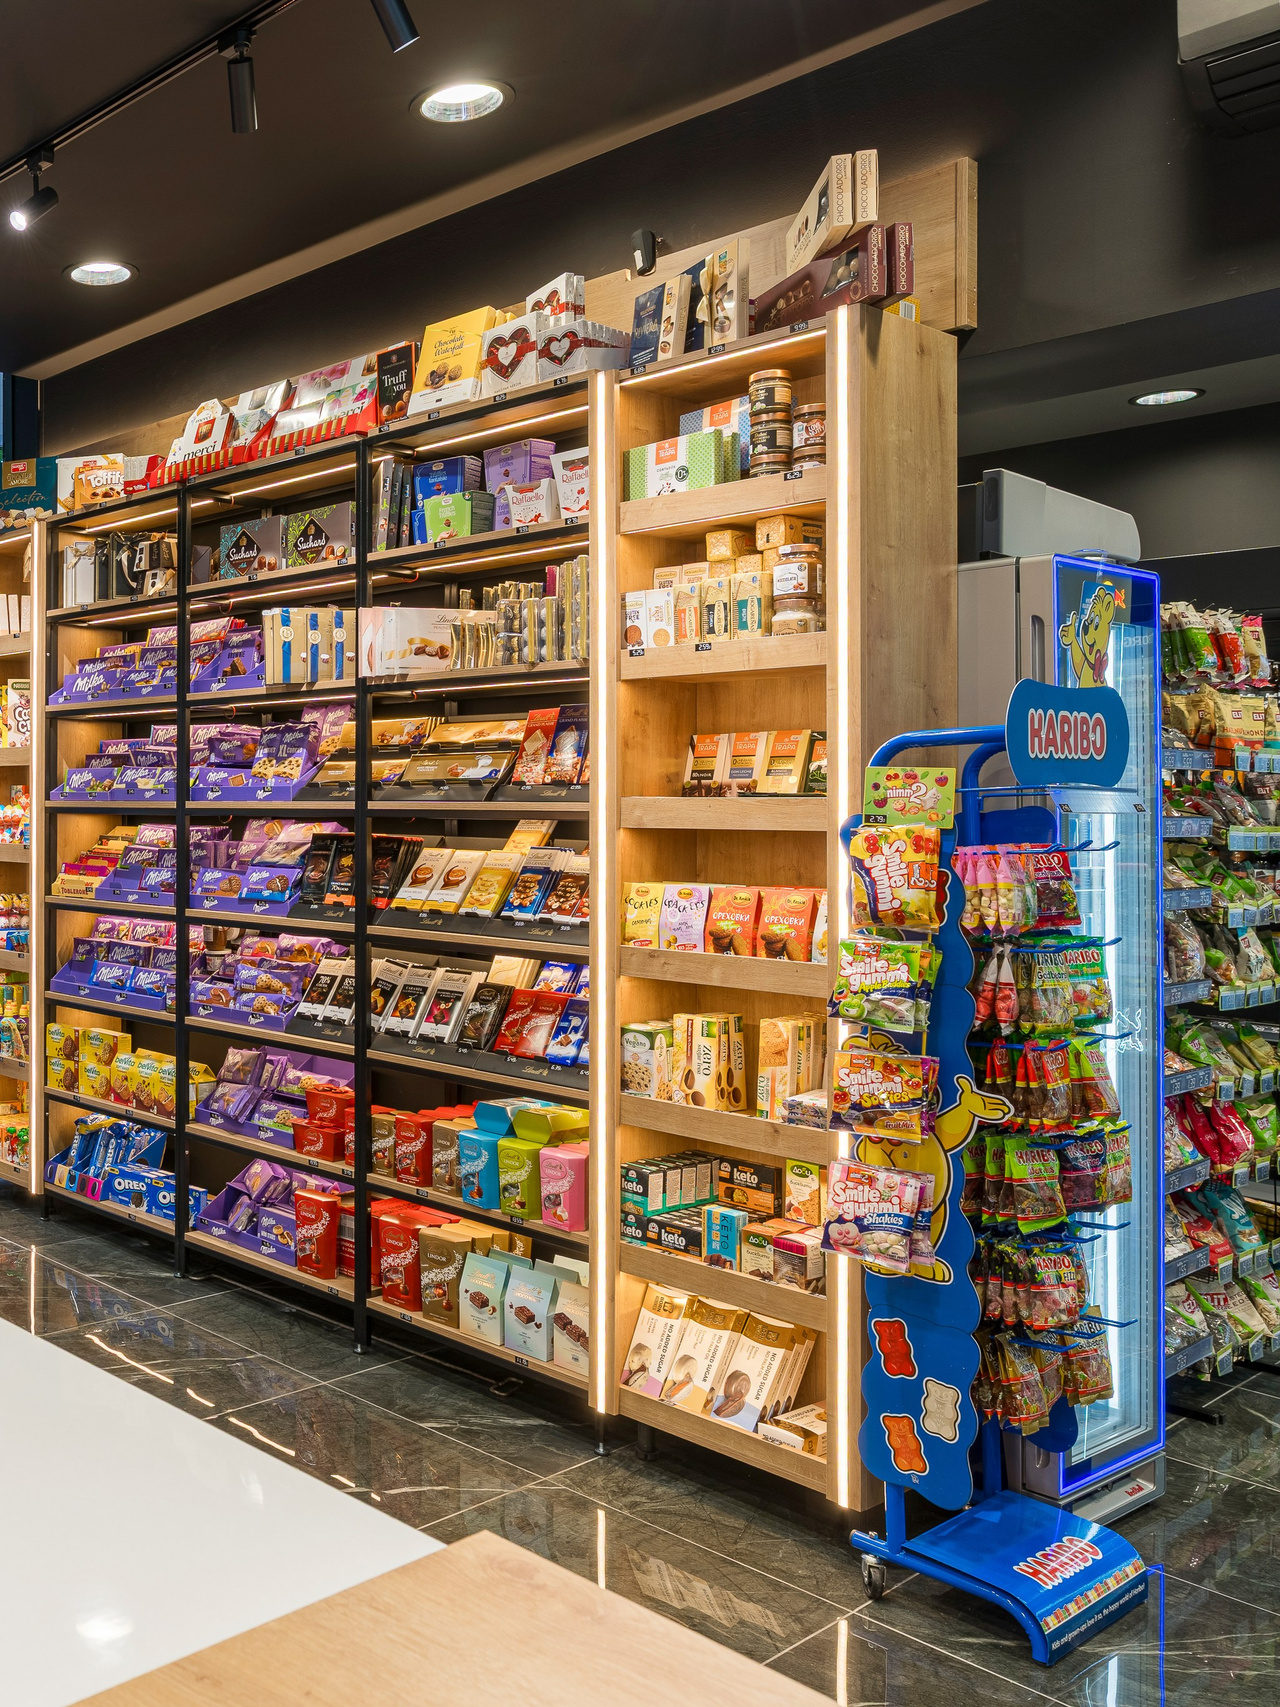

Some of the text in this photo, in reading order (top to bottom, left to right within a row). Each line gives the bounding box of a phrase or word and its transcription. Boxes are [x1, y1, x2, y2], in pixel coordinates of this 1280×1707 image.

[434, 335, 464, 349] Chocolate
[383, 370, 407, 388] Truff
[183, 441, 217, 461] merci
[512, 494, 544, 505] Raffaello
[298, 536, 326, 550] Suchard
[229, 549, 258, 562] Suchard
[73, 671, 105, 693] Milka
[1029, 709, 1106, 759] HARIBO
[70, 771, 93, 788] Milka
[121, 767, 149, 782] Milka
[201, 870, 222, 883] Milka
[248, 870, 270, 883] Milka
[865, 839, 909, 912] Smile gummi
[625, 897, 659, 909] COOKIES
[712, 912, 750, 922] ОРЕХОВКИ
[765, 916, 805, 925] ОРЕХОВКИ
[97, 966, 123, 982] Milka
[840, 956, 889, 976] Smile
[136, 971, 161, 985] Milka
[850, 966, 909, 992] gummi
[48, 1028, 65, 1038] belVita
[624, 1037, 646, 1048] Vegano
[115, 1056, 135, 1067] belVita
[839, 1068, 883, 1087] Smile
[849, 1077, 902, 1100] gummi
[1015, 1149, 1057, 1165] HARIBO
[734, 1168, 758, 1183] keto
[113, 1177, 147, 1191] OREO
[622, 1180, 643, 1193] keto
[832, 1182, 881, 1203] Smile
[300, 1210, 315, 1220] LINDOR
[842, 1197, 902, 1220] gummi
[864, 1213, 904, 1226] Shakies
[621, 1223, 642, 1238] keto
[662, 1228, 686, 1246] keto
[721, 1216, 729, 1250] KETO
[386, 1238, 403, 1247] LINDOR
[427, 1252, 447, 1262] LINDOR
[1035, 1255, 1071, 1271] HARIBO
[664, 1331, 672, 1354] ADDED
[710, 1343, 720, 1363] ADDED
[657, 1354, 665, 1373] SUGAR
[765, 1360, 774, 1381] ADDED
[702, 1364, 712, 1383] SUGAR
[755, 1382, 765, 1401] SUGAR
[1013, 1536, 1102, 1589] HARIBO
[1052, 1640, 1060, 1650] Kids
[1060, 1634, 1068, 1644] and
[1068, 1622, 1087, 1641] grown-ups
[1087, 1617, 1095, 1627] love
[1095, 1614, 1097, 1622] it
[1109, 1602, 1119, 1614] happy
